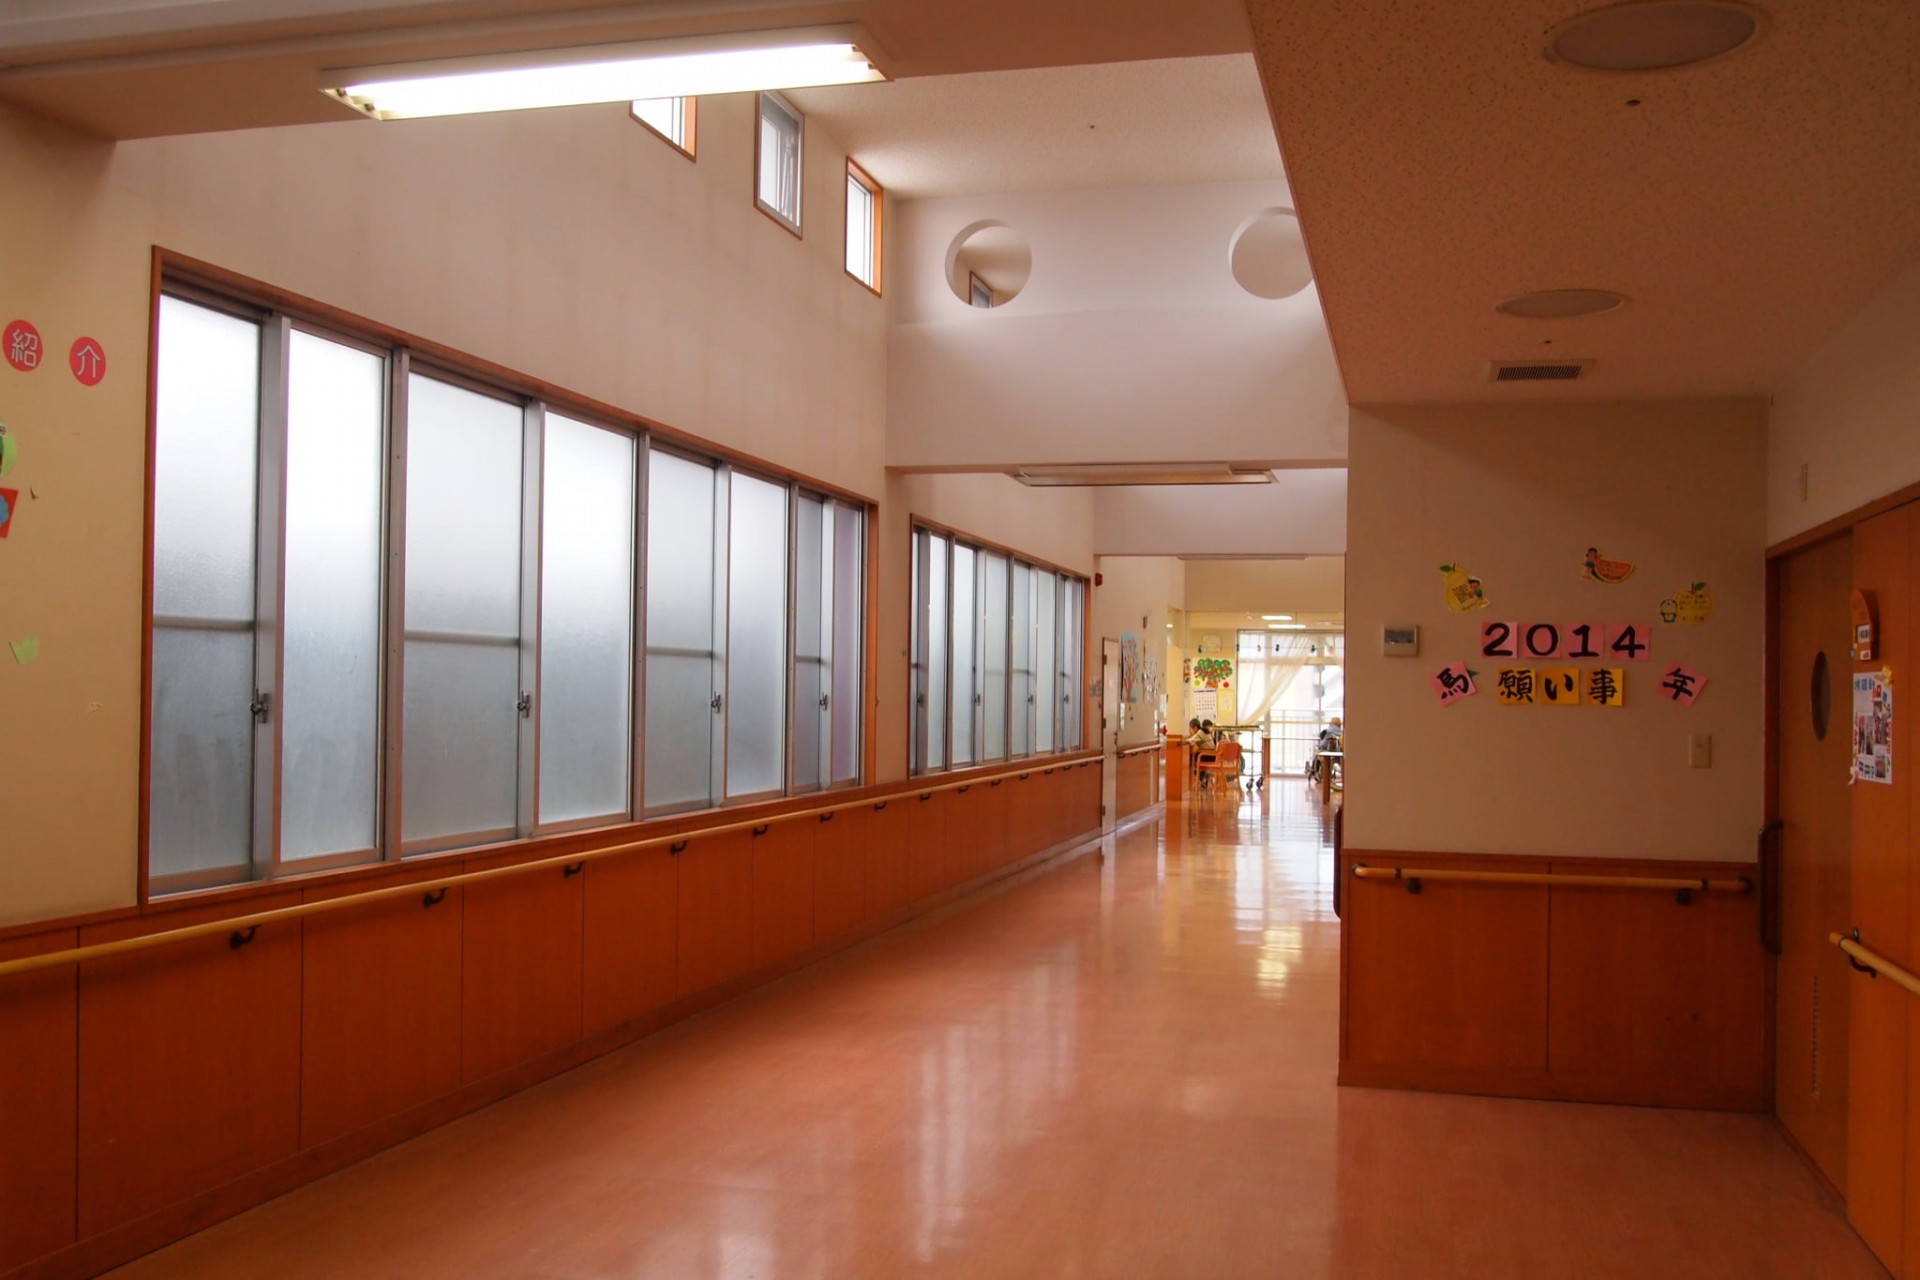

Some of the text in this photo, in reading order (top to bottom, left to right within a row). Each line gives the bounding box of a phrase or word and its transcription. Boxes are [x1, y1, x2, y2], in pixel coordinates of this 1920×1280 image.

[11, 329, 100, 379] 紹介
[1482, 623, 1646, 658] 2014
[1436, 667, 1696, 704] 馬 願い事 年
